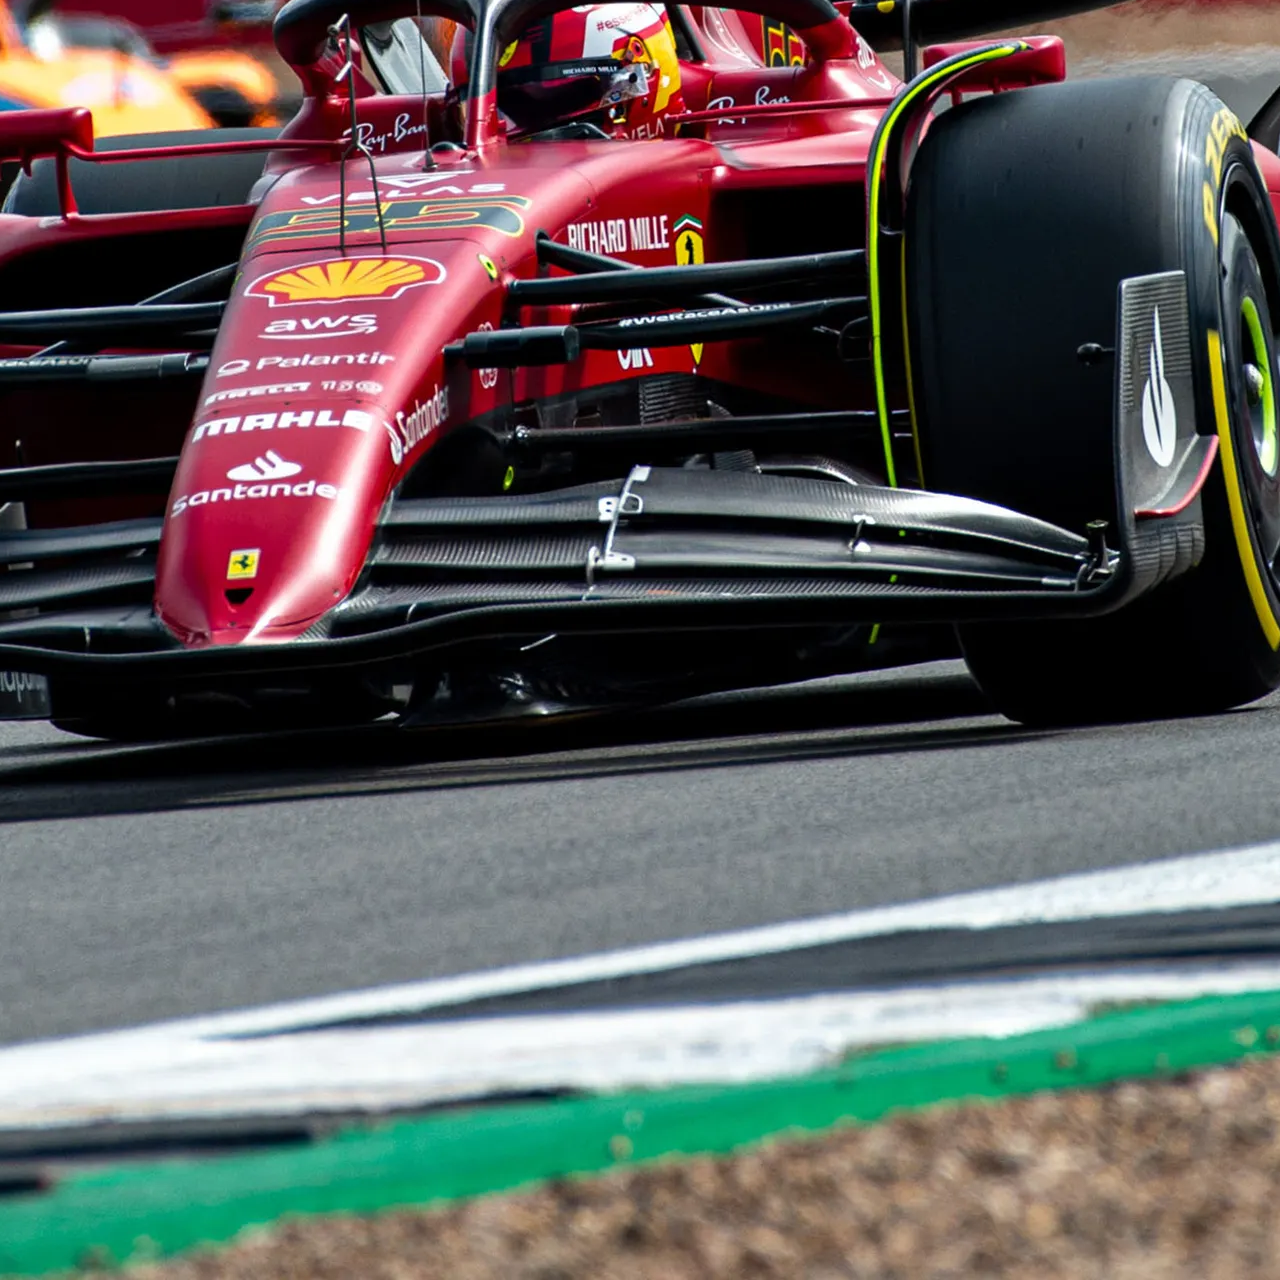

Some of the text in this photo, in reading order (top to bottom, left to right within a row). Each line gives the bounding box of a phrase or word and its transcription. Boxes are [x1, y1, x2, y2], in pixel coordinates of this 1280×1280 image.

[301, 183, 506, 205] VELAS
[247, 195, 532, 250] 55
[567, 214, 670, 255] RICHARD MILLE
[264, 313, 378, 333] aws
[618, 302, 793, 328] #WeRaceAsOne
[256, 351, 396, 372] Palantir
[192, 409, 376, 444] MAHLE
[395, 383, 451, 455] Santander
